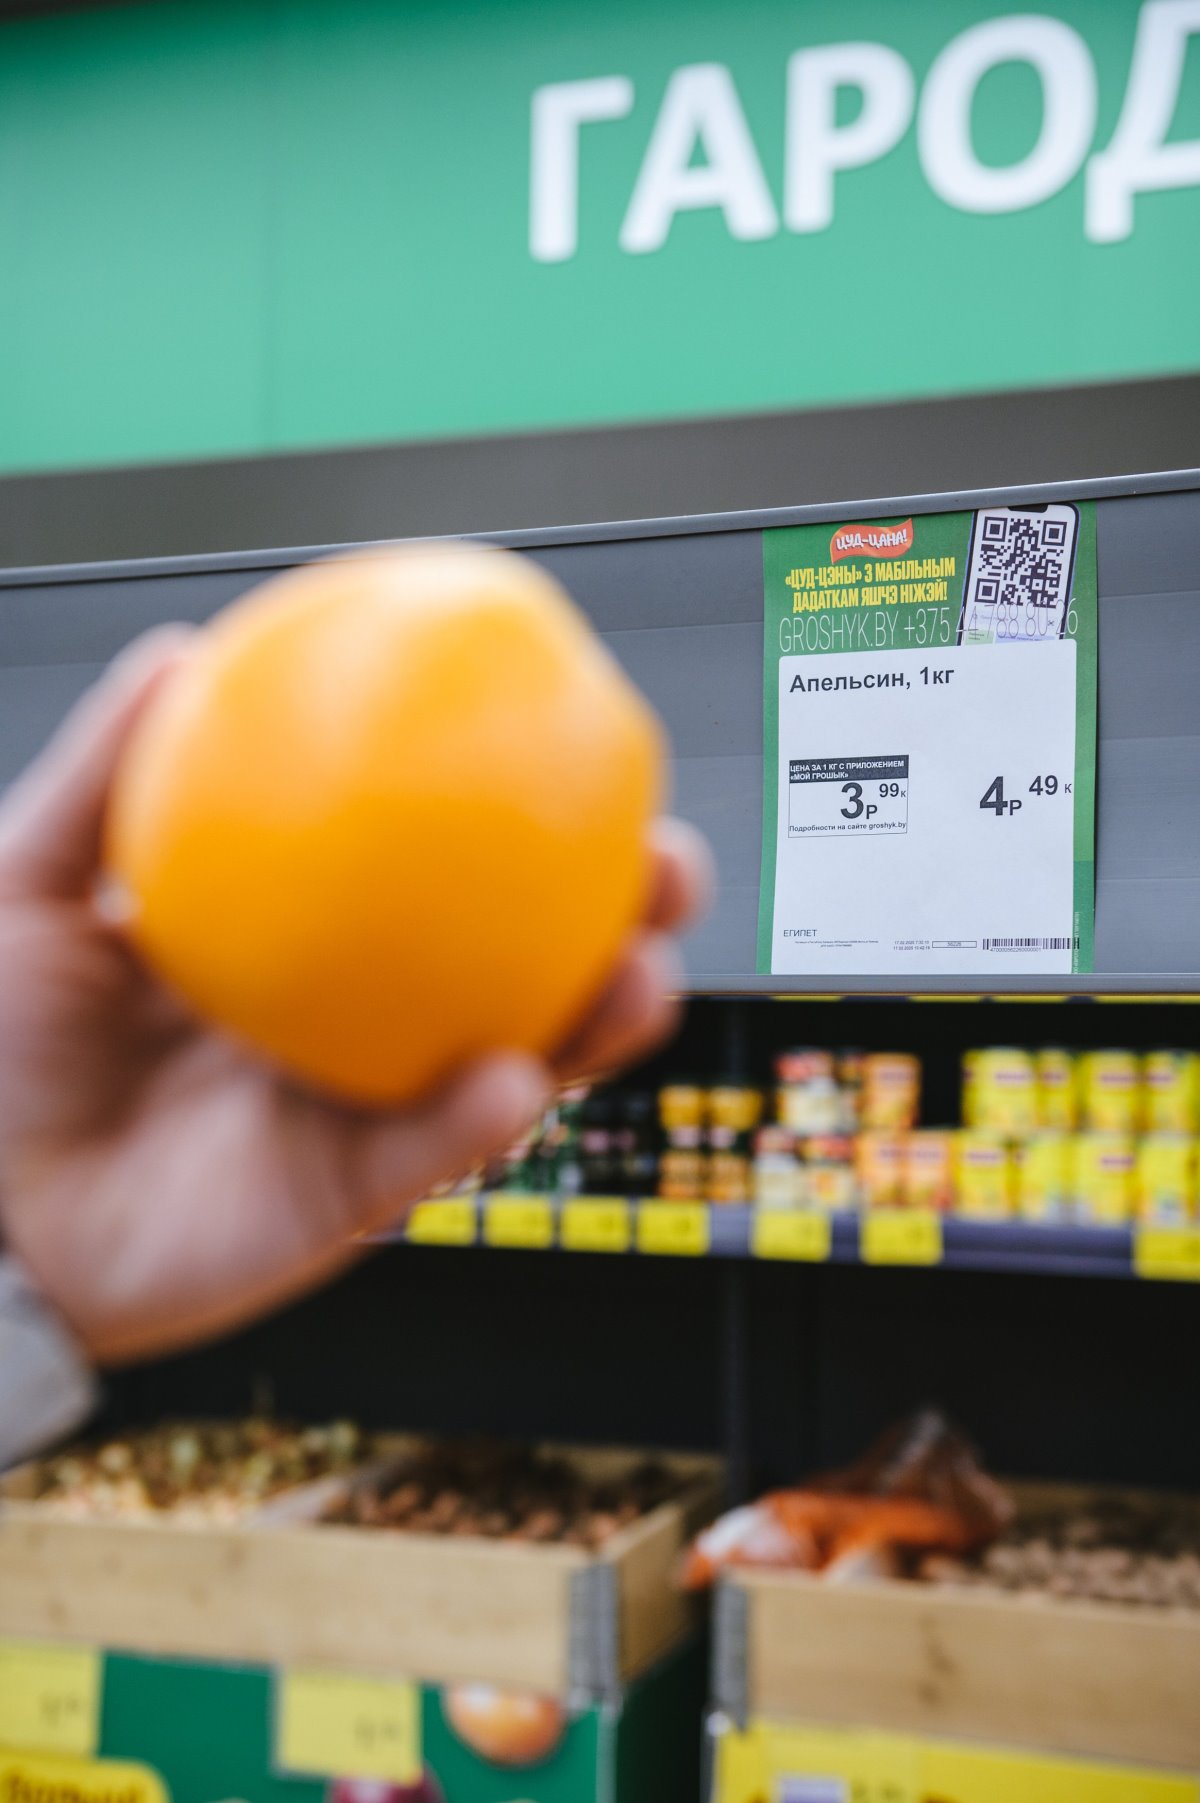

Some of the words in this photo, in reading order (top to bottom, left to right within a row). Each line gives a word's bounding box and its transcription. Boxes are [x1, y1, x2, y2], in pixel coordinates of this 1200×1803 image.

[836, 528, 908, 551] ЦУД-ЦАНА!
[785, 564, 862, 590] «ЦУД-ЦЭНЫ»
[875, 557, 956, 583] МАБІЛЬНЫМ
[792, 588, 859, 613] ДАДАТКАМ
[861, 586, 898, 607] ЯШЧЭ
[900, 579, 948, 603] НІЖЭЙ!
[779, 611, 899, 653] GROSHYK.BY
[903, 607, 950, 645] +375
[789, 672, 911, 693] Апельсин,
[919, 666, 955, 685] 1кг
[790, 764, 810, 773] ЦЕНА
[828, 763, 838, 771] КГ
[846, 760, 905, 770] ПРИЛОЖЕНИЕМ
[879, 782, 900, 798] 99
[1028, 775, 1058, 796] 49
[789, 824, 836, 833] Подробности
[868, 821, 906, 831] groshyk.by
[783, 929, 818, 937] ЕГИПЕТ
